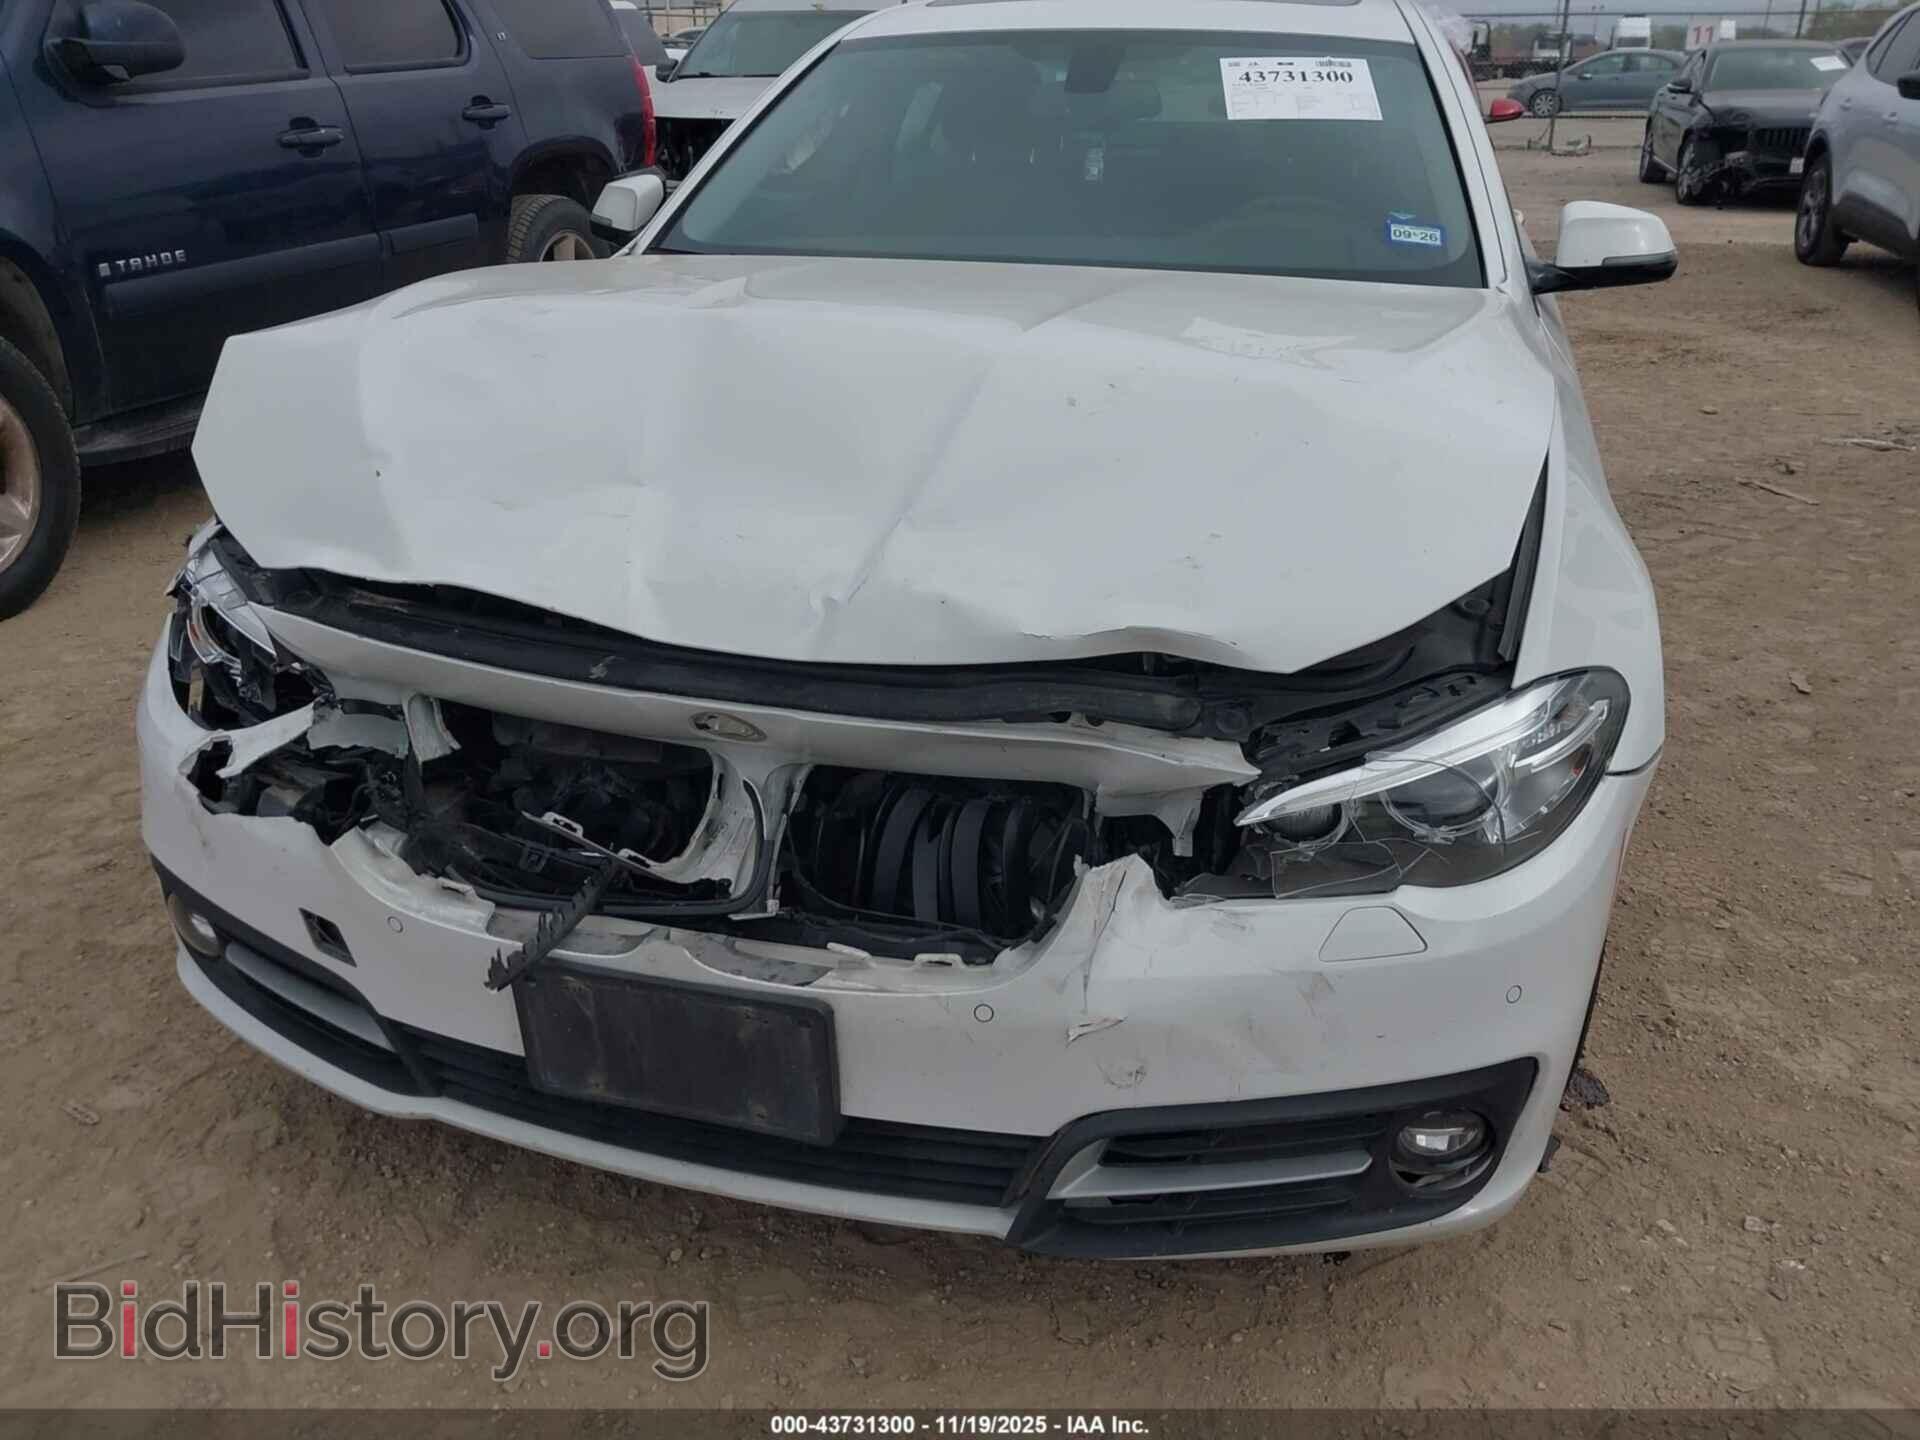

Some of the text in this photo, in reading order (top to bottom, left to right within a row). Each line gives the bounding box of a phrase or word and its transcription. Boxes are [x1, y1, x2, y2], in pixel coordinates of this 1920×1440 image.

[1693, 26, 1713, 44] 11
[1238, 70, 1354, 83] 43731300
[115, 249, 186, 273] TAHOE
